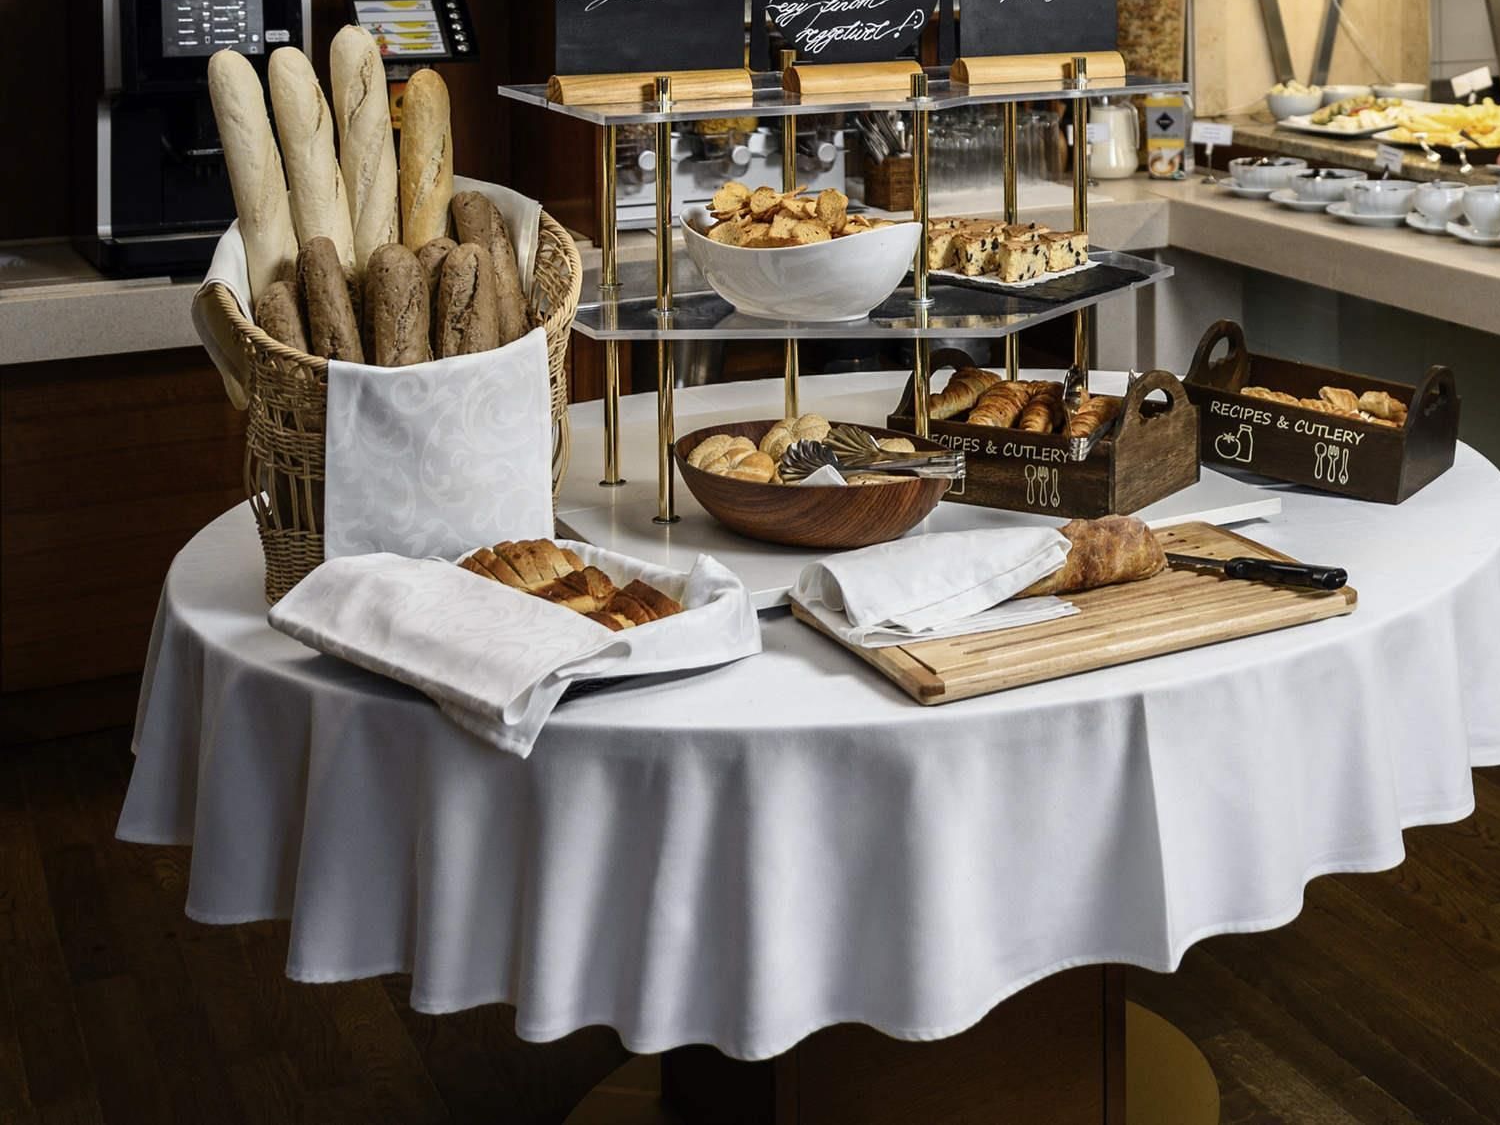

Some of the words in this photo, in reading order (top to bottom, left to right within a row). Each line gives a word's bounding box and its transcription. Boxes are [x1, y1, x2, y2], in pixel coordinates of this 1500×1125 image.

[1210, 400, 1272, 425] RECIPES
[1276, 415, 1290, 430] &
[1294, 419, 1365, 446] CUTLERY
[931, 433, 981, 452] ECIPES
[985, 440, 998, 455] &
[1002, 442, 1070, 464] CUTLERY
